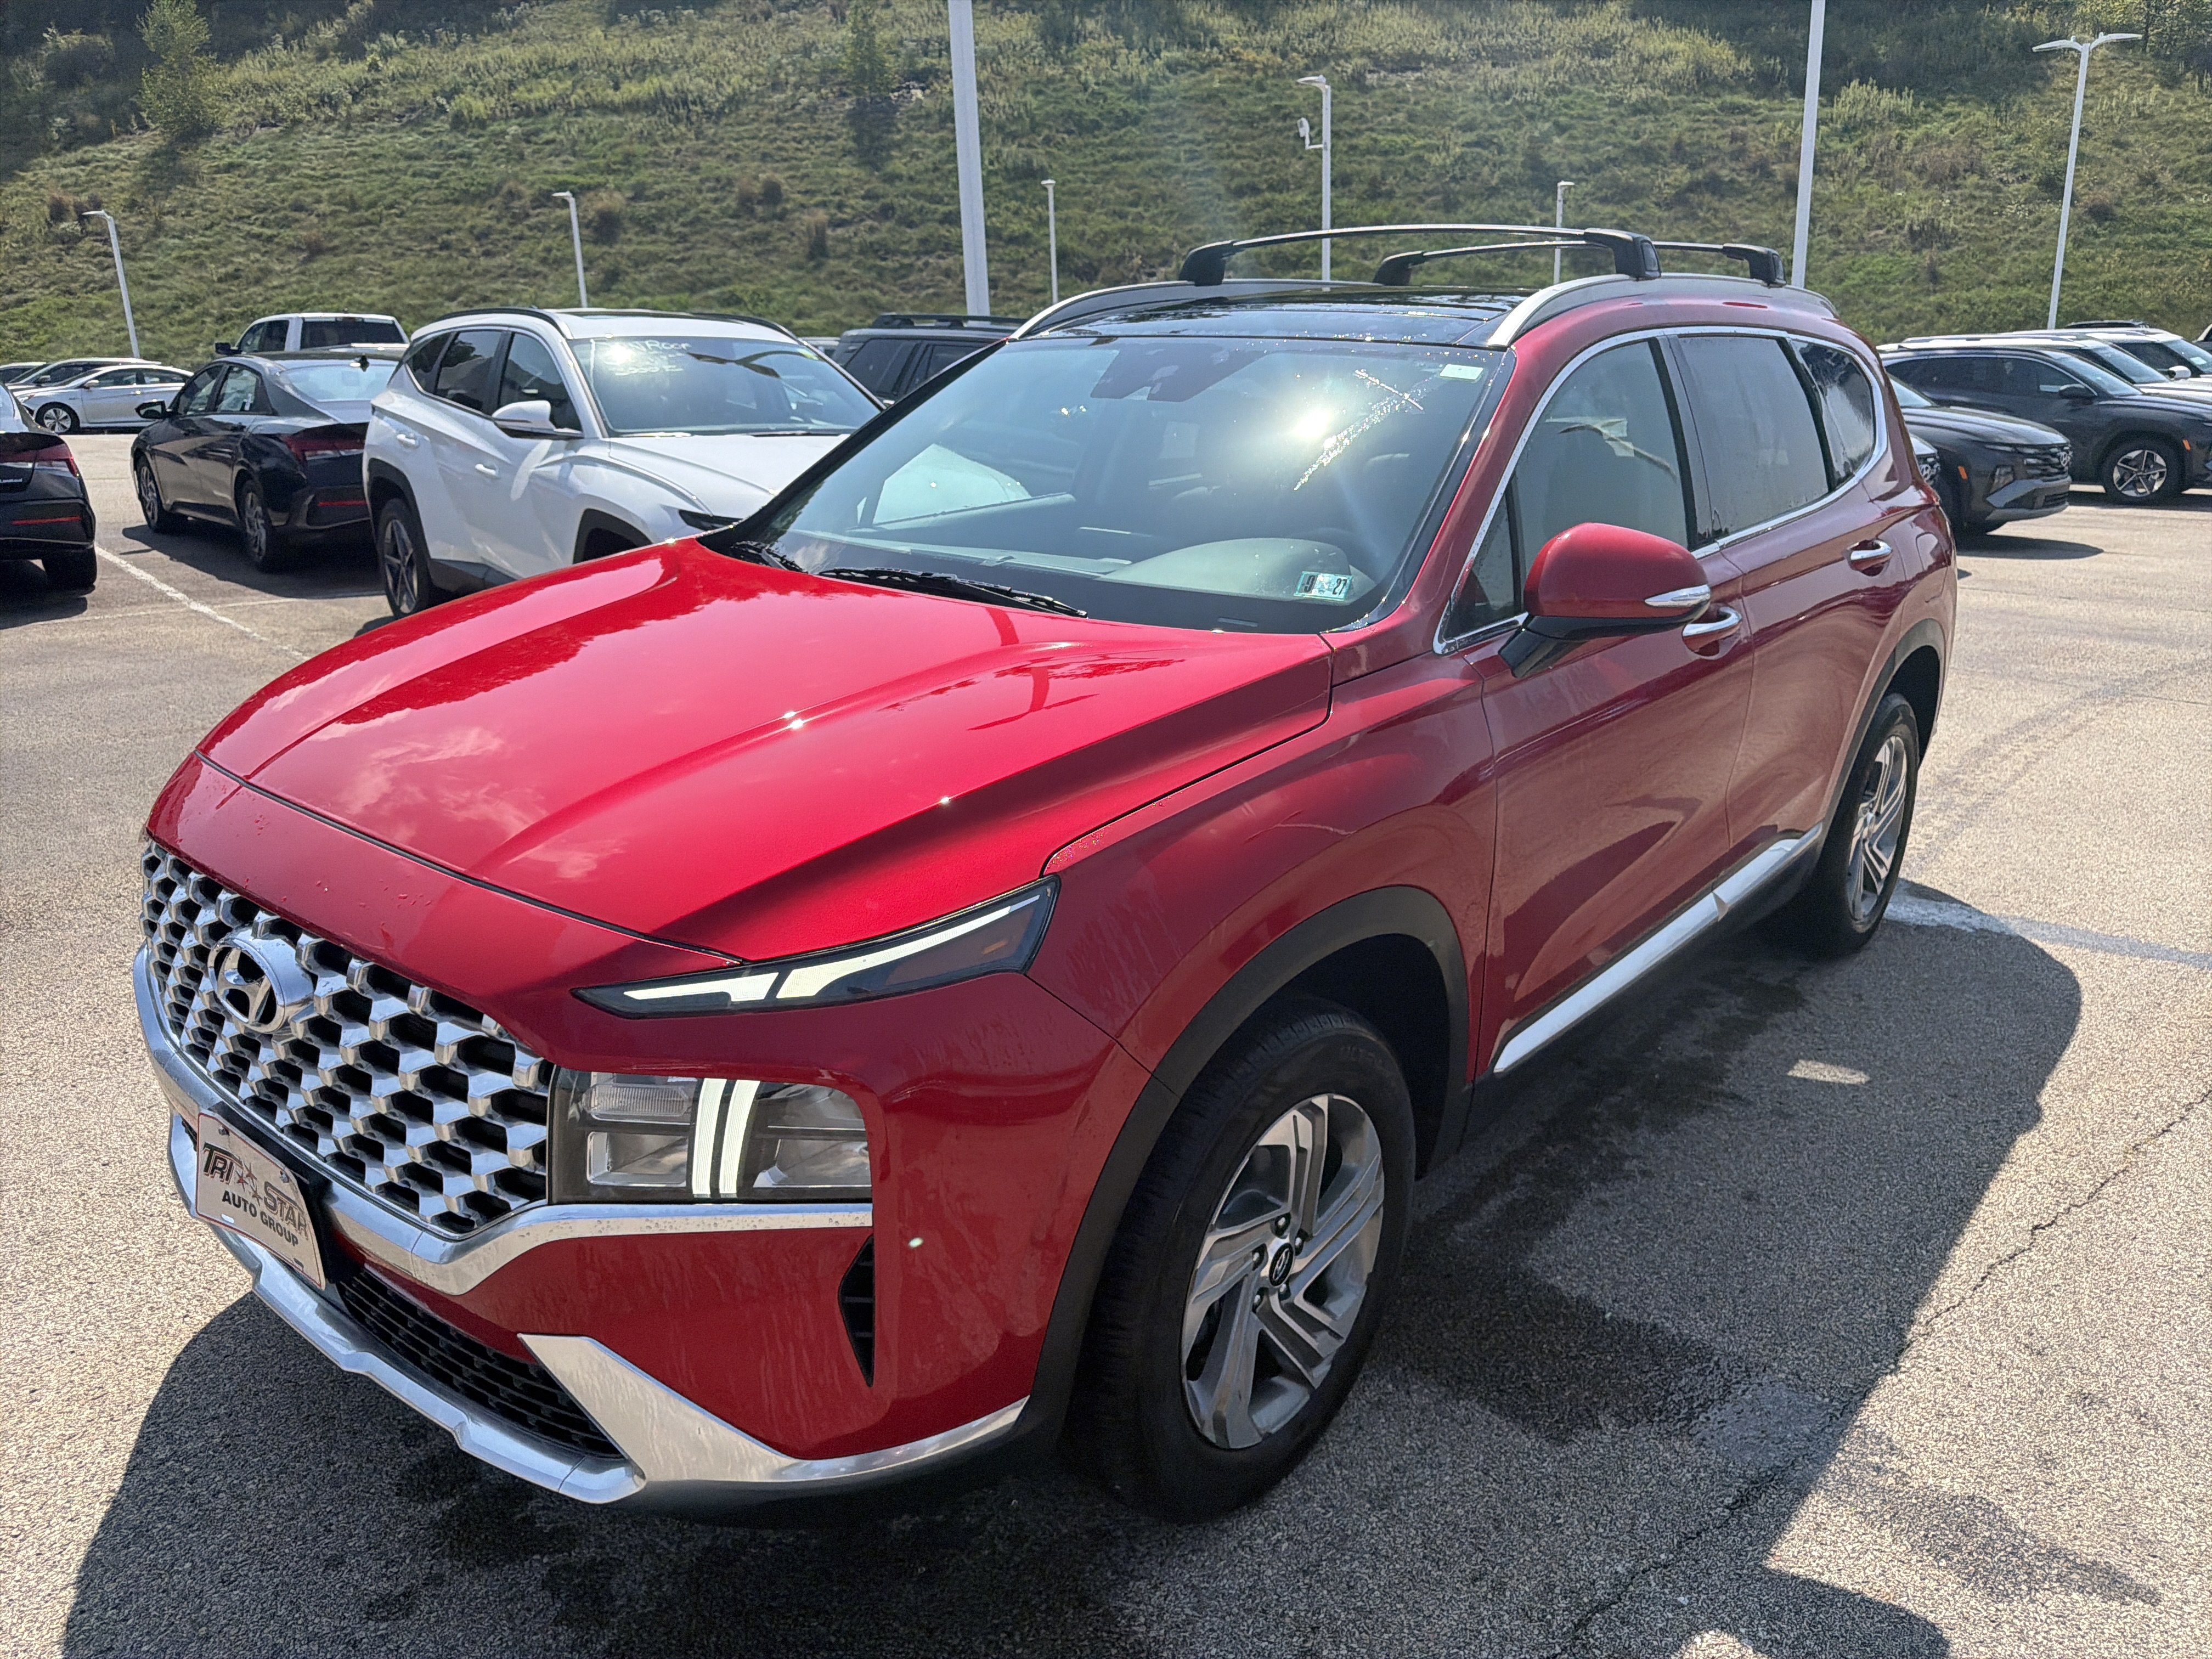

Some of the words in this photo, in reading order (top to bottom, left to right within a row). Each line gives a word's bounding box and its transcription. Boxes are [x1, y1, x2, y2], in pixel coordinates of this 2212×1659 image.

[1332, 578, 1347, 595] 27
[202, 1142, 244, 1185] TRI
[264, 1181, 309, 1240] STAR
[222, 1190, 257, 1217] AUTO
[260, 1211, 299, 1246] GROUP
